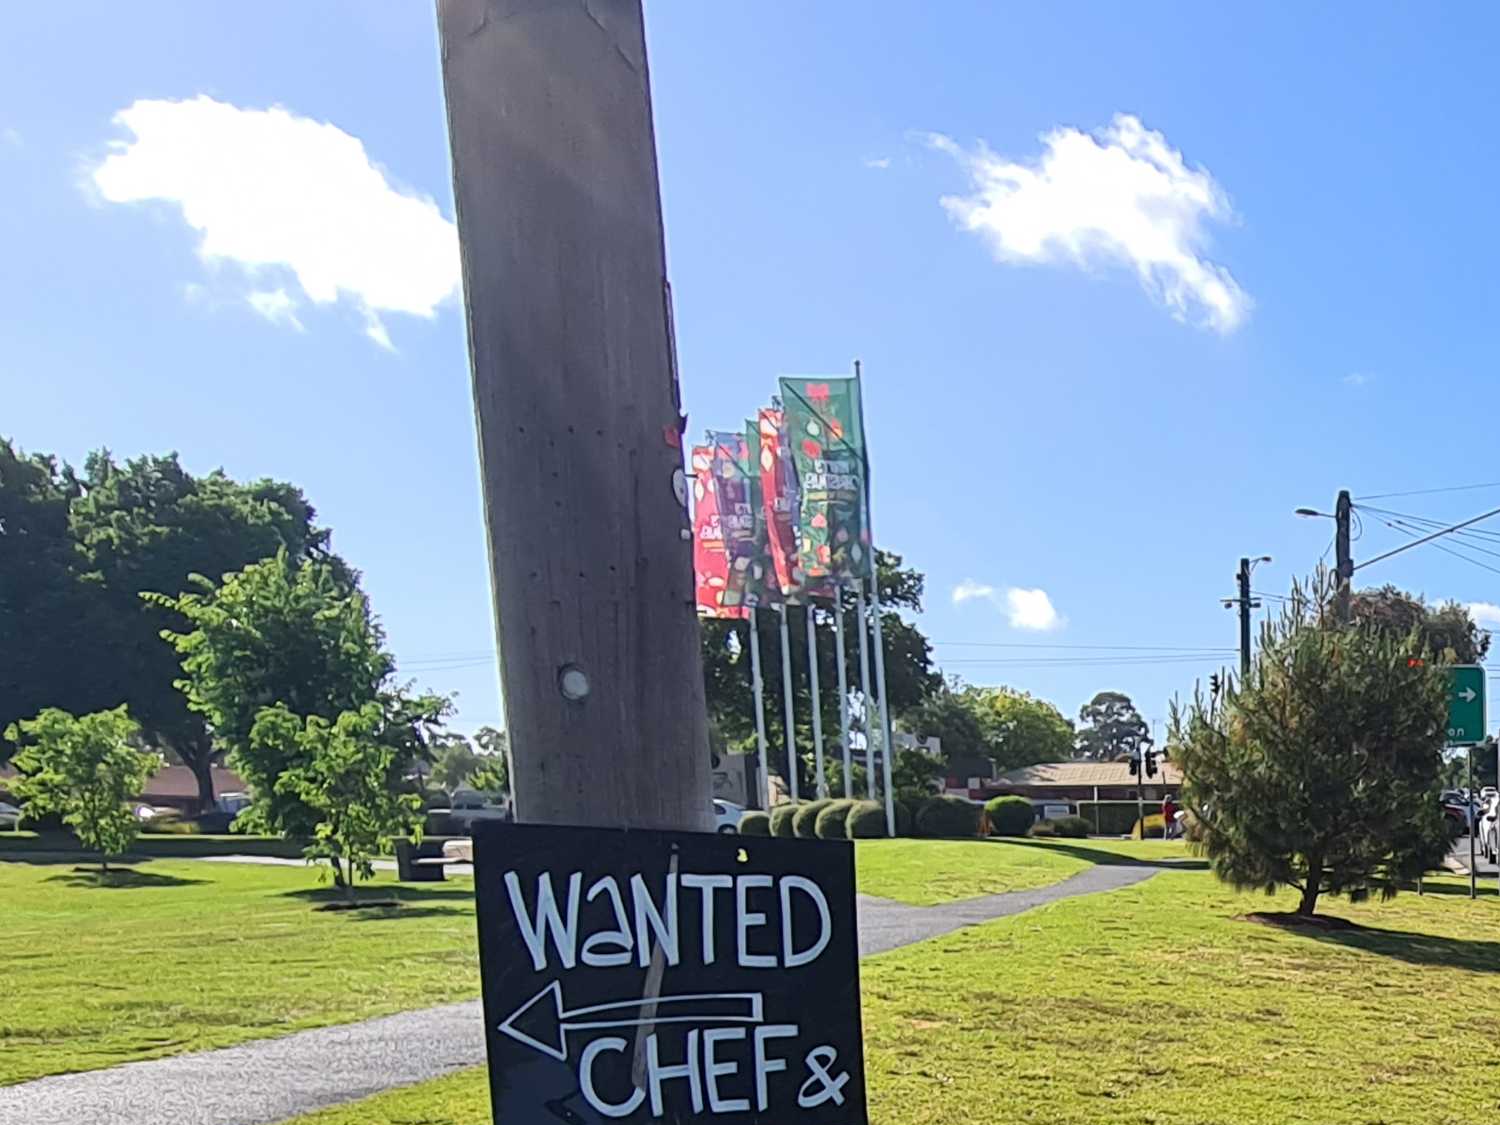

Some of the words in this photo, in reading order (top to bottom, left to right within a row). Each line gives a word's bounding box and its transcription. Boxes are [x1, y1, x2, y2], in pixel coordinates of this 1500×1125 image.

[504, 871, 831, 971] WaNTED
[579, 1024, 798, 1117] CHEF
[797, 1045, 851, 1108] &
